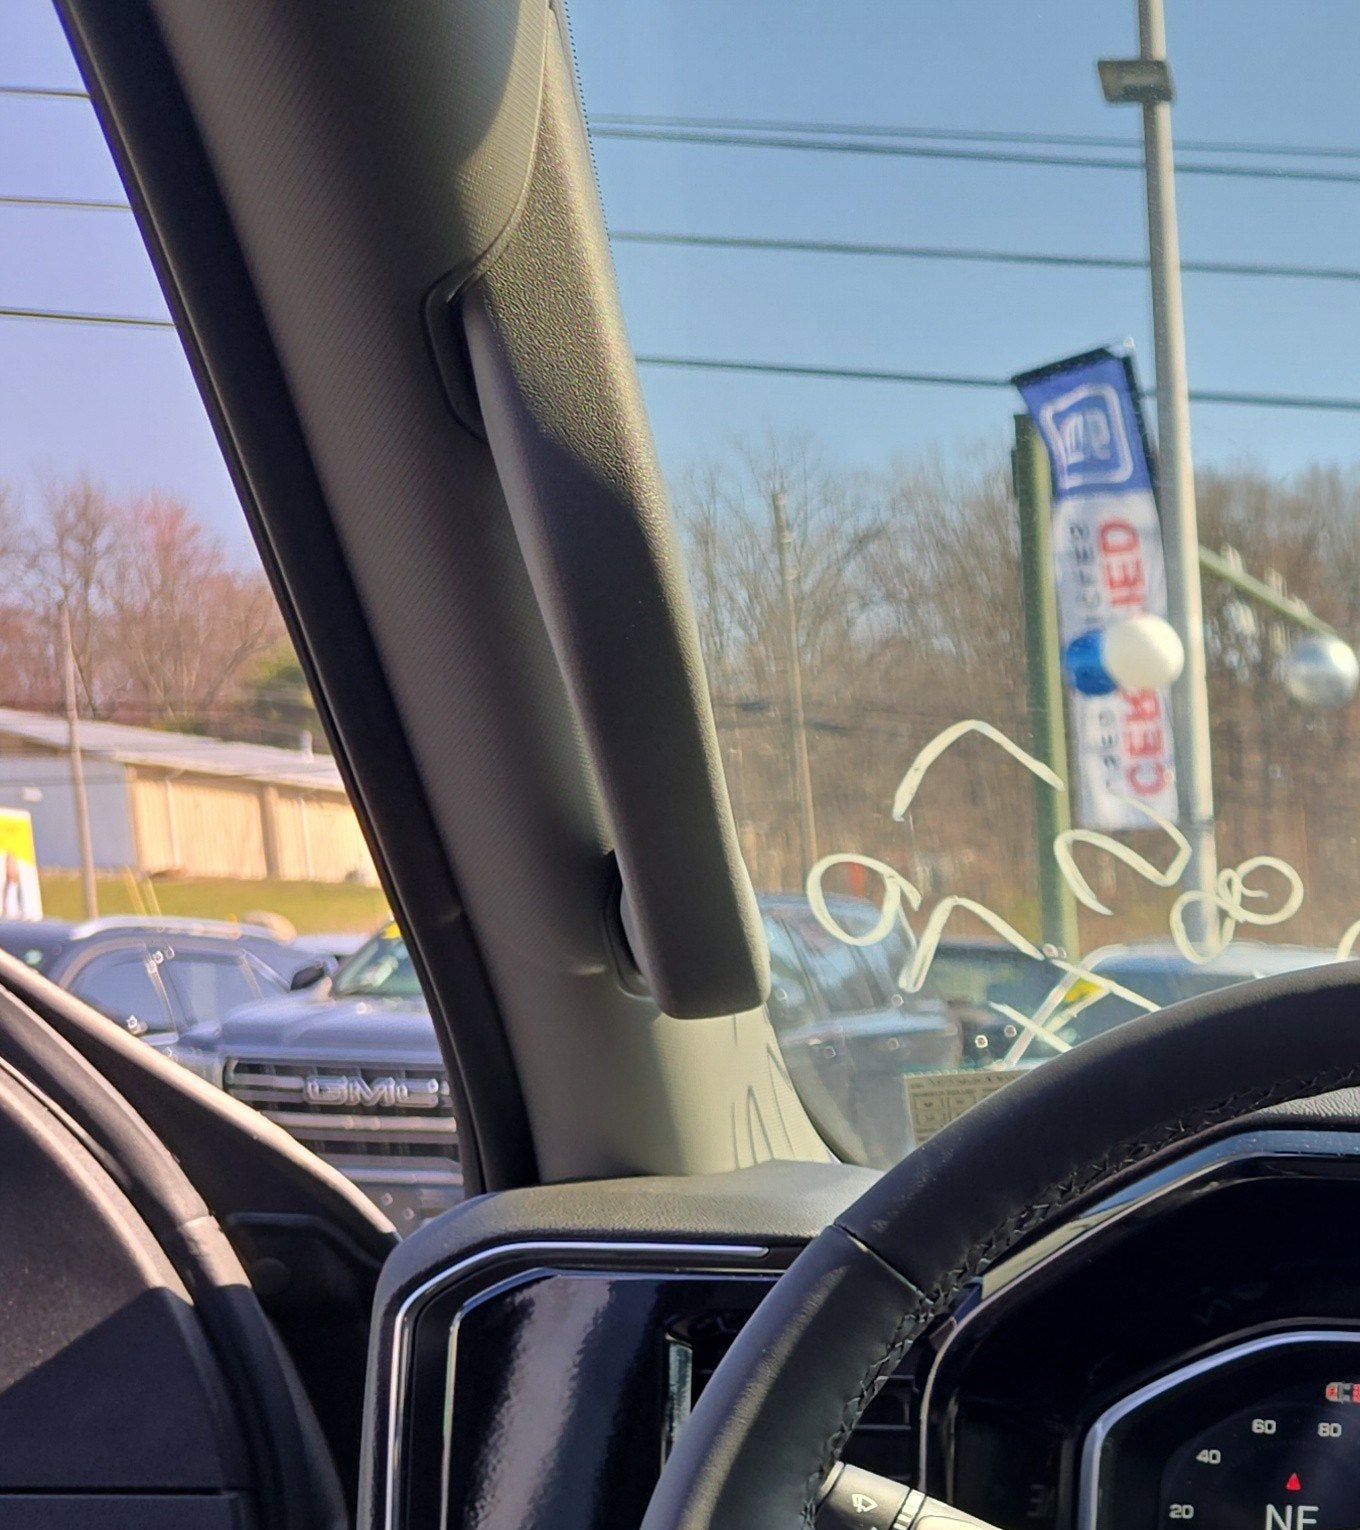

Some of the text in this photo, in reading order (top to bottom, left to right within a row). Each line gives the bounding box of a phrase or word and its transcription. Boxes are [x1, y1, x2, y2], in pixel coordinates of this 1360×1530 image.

[304, 1075, 439, 1108] GMC
[1252, 1419, 1277, 1434] 60
[1317, 1422, 1342, 1438] 80
[1195, 1449, 1221, 1465] 40
[1168, 1504, 1194, 1519] 20
